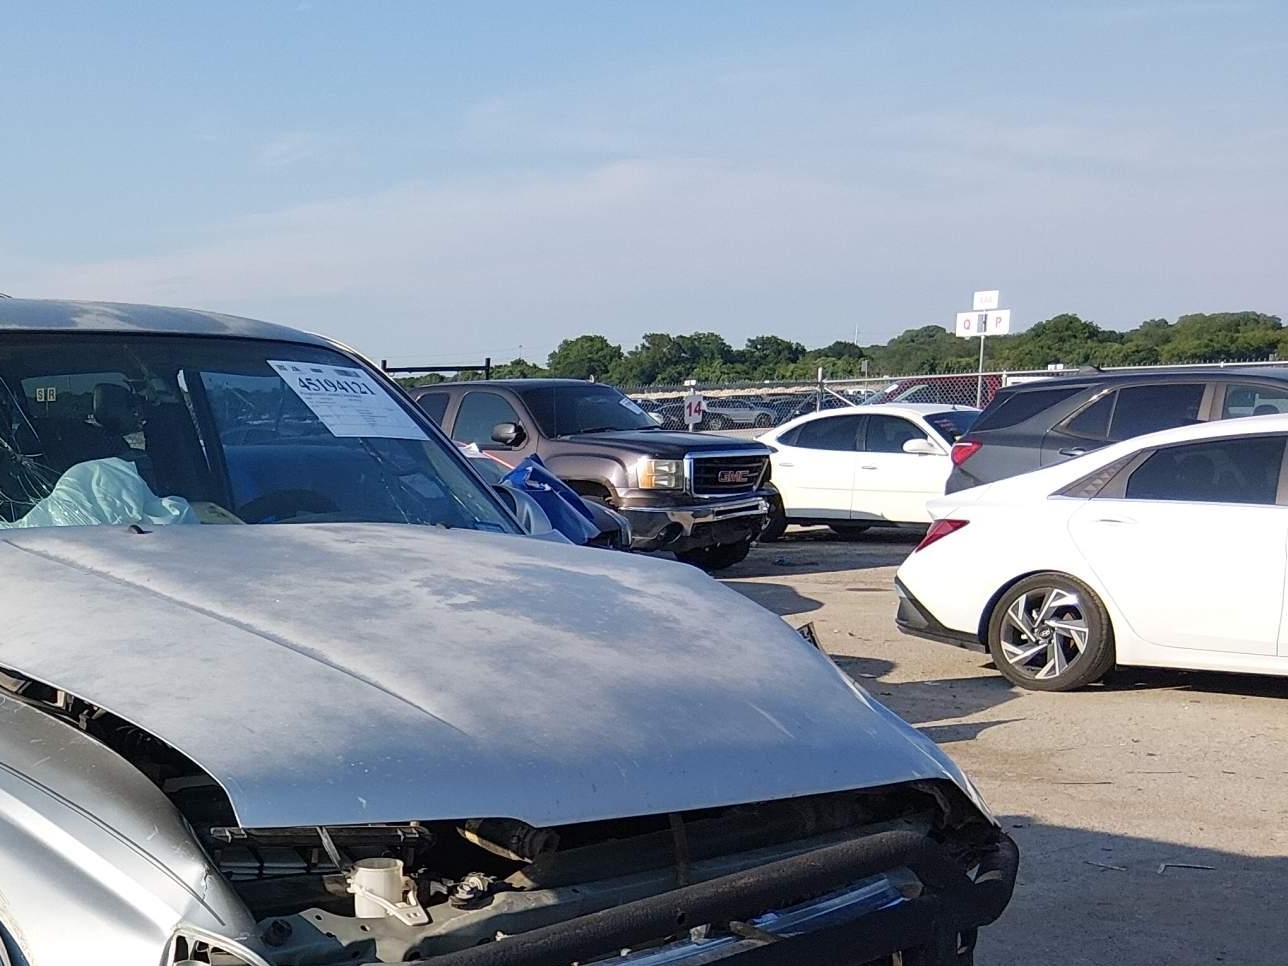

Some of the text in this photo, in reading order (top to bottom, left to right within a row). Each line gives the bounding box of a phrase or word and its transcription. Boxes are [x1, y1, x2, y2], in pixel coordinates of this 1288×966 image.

[298, 377, 376, 395] 45194121
[686, 400, 702, 417] 14
[718, 470, 750, 483] GMC
